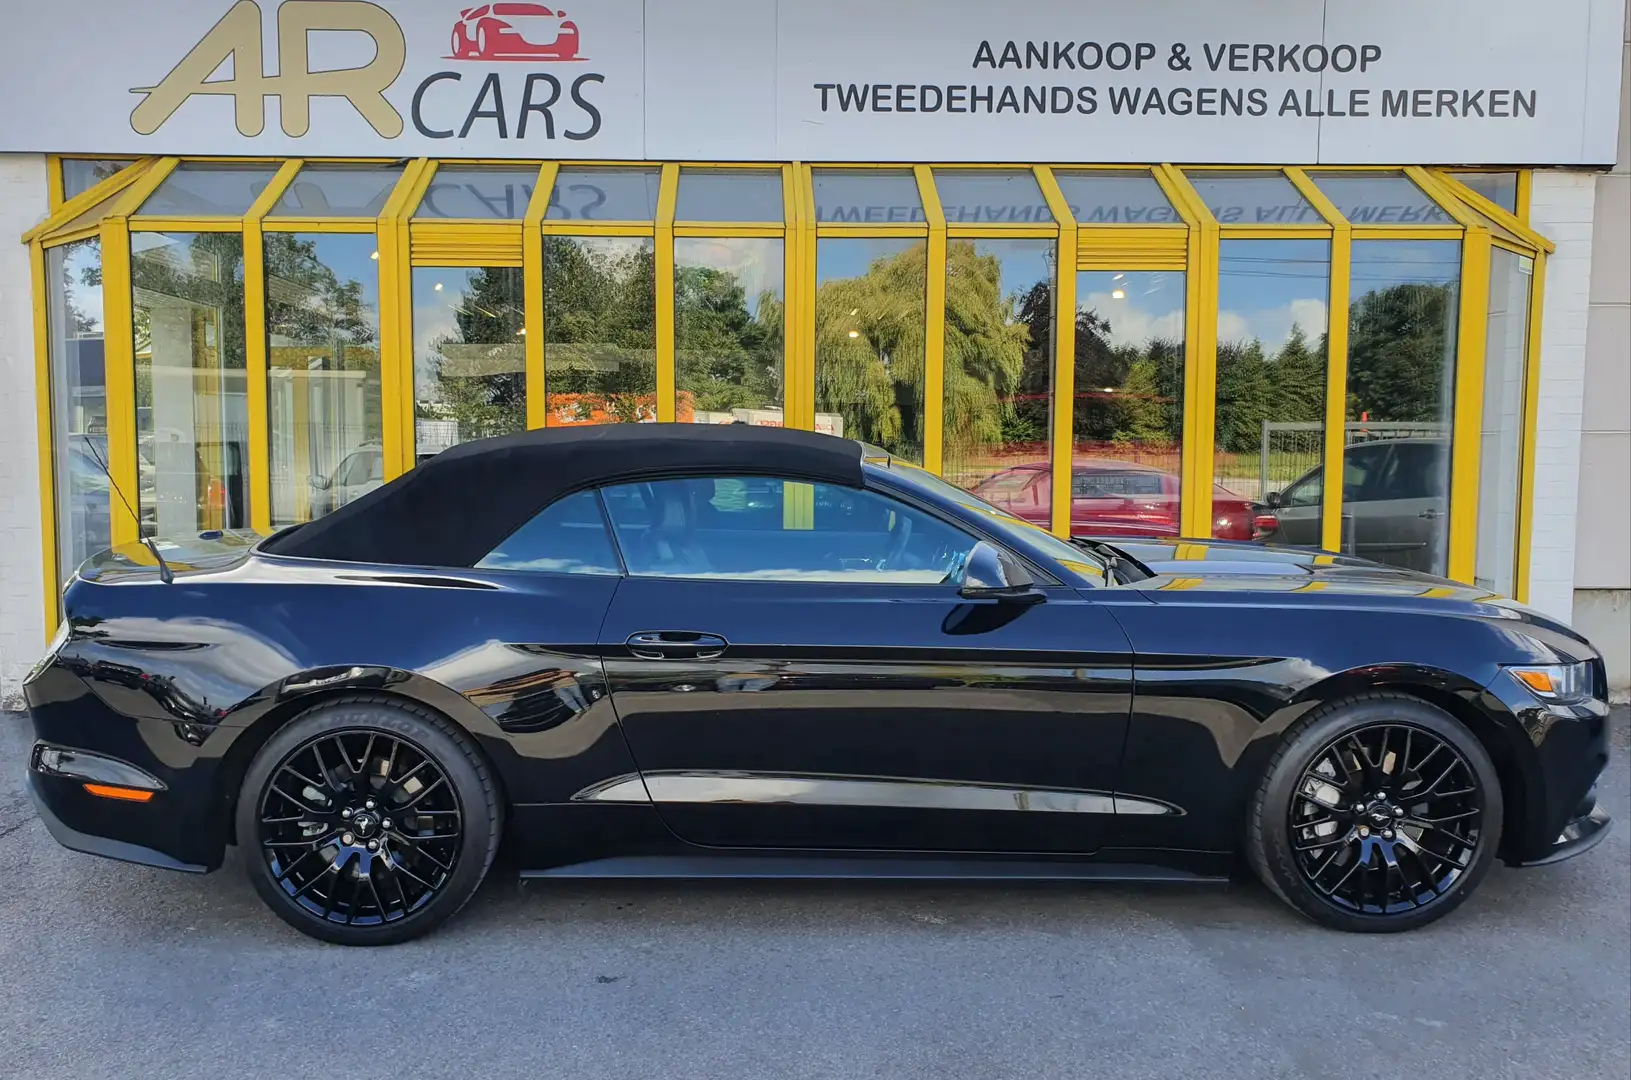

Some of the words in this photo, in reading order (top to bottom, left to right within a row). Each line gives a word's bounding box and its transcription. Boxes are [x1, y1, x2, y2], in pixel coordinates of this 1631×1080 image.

[129, 0, 405, 138] AR
[412, 72, 605, 141] CARS
[973, 40, 1155, 71] AANKOOP
[1168, 43, 1192, 71] &
[1203, 43, 1381, 73] VERKOOP
[814, 84, 1097, 115] TWEEDEHANDS
[1109, 87, 1267, 117] WAGENS
[1279, 89, 1369, 117] ALLE
[1382, 90, 1536, 118] MERKEN
